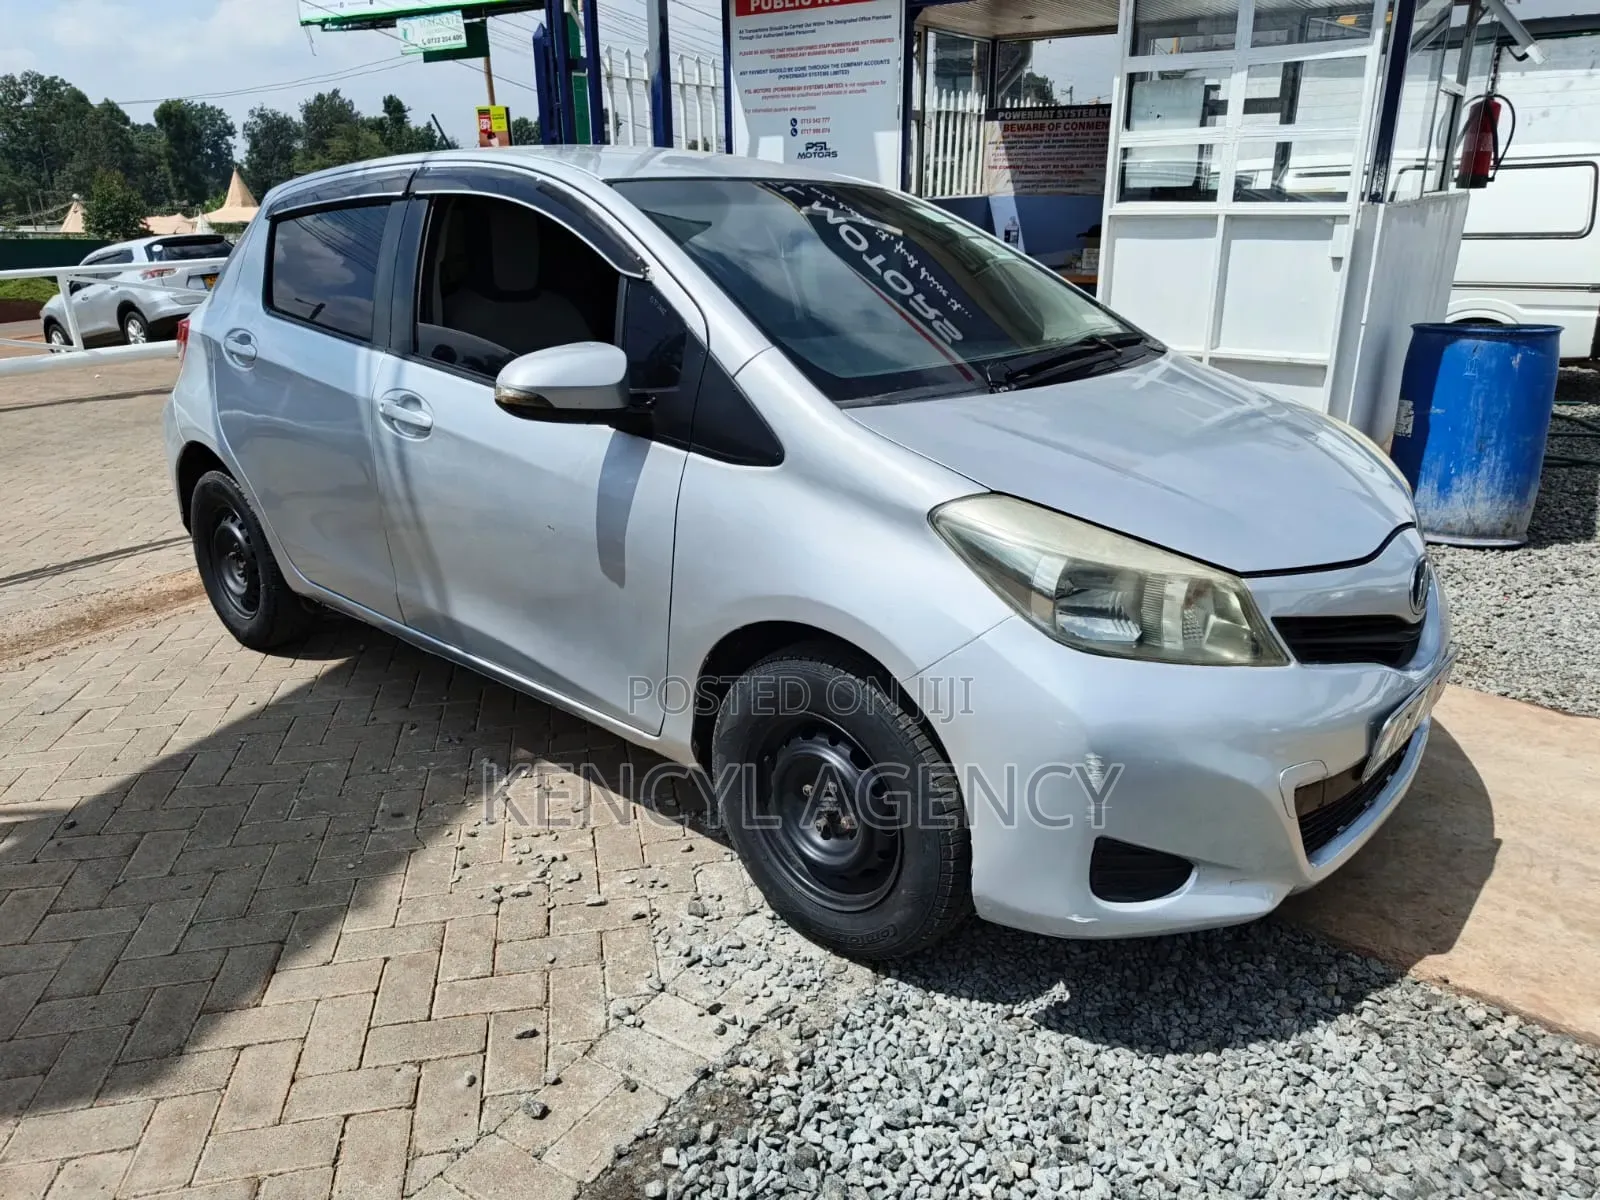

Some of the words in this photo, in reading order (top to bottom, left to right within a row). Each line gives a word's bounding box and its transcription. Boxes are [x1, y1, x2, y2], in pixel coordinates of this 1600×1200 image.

[998, 110, 1056, 120] POWERMAT
[1056, 108, 1098, 119] SYSTEM
[1002, 122, 1047, 132] BEWARE
[1048, 122, 1062, 132] OF
[805, 142, 831, 151] PSL
[797, 150, 838, 160] MOTORS
